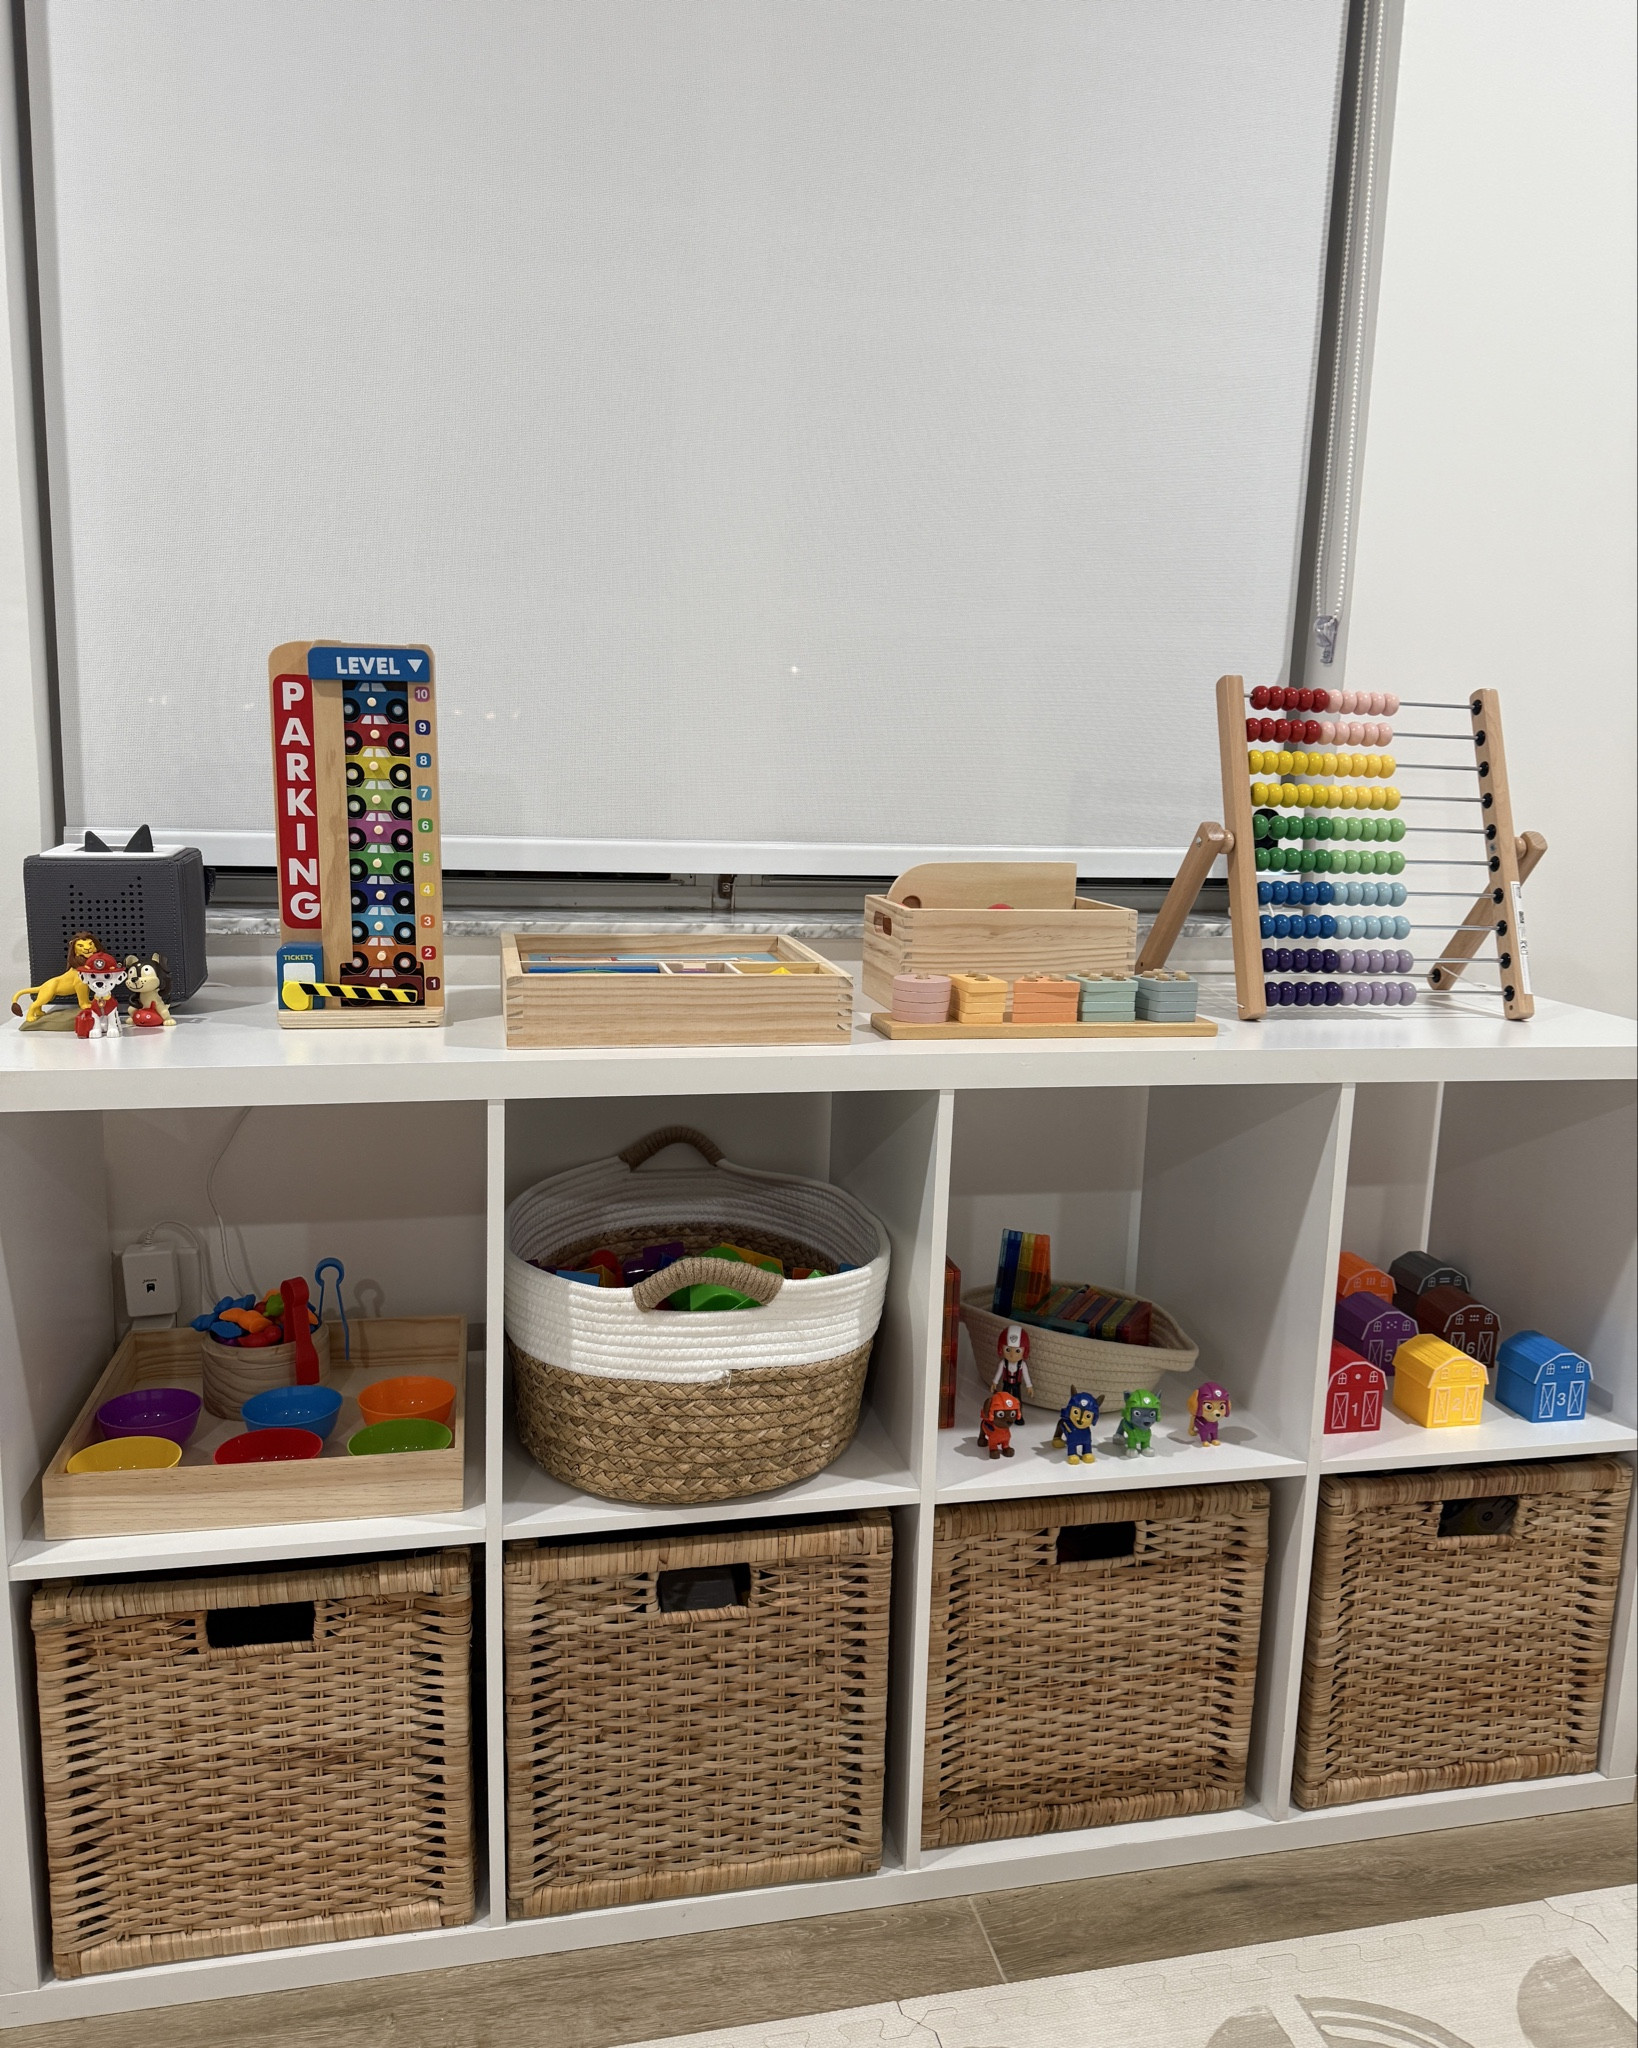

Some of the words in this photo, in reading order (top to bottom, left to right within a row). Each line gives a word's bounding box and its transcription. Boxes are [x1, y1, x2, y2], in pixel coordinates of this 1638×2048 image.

[336, 656, 400, 675] LEVEL
[415, 689, 427, 699] 10
[418, 722, 427, 733] 9
[419, 756, 427, 766] 8
[421, 788, 428, 798] 7
[280, 681, 321, 921] PARKING
[422, 821, 429, 831] 6
[422, 853, 430, 862] 5
[423, 885, 430, 894] 4
[424, 916, 431, 926] 3
[424, 947, 432, 957] 2
[431, 978, 436, 988] 1
[1466, 1342, 1476, 1354] 6
[1384, 1350, 1393, 1362] 5
[1451, 1397, 1461, 1411] 2
[1556, 1392, 1566, 1406] 3
[1351, 1402, 1358, 1416] 1
